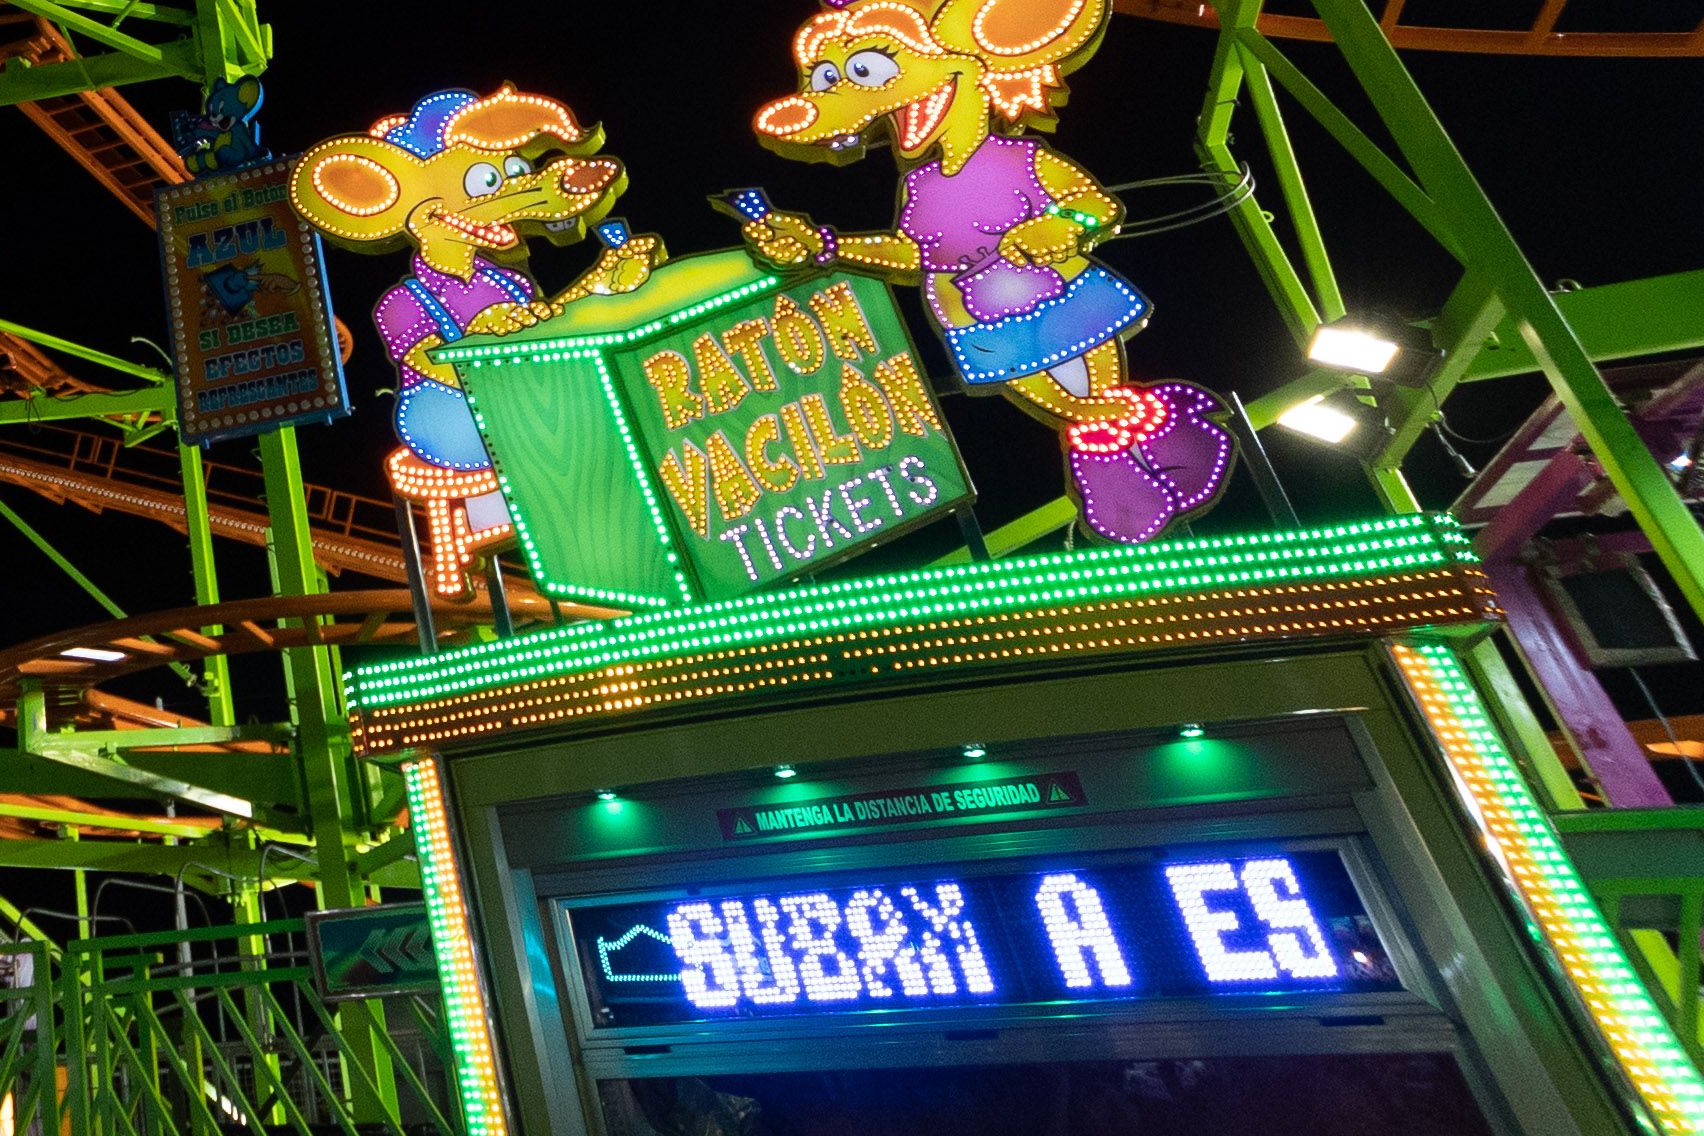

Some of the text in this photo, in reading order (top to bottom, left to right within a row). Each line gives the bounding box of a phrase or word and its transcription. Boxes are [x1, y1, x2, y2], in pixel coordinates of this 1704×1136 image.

[174, 201, 218, 224] Pulse
[224, 192, 237, 212] el
[187, 216, 287, 268] AZUL
[199, 311, 300, 351] SI DESEA
[203, 339, 305, 381] EFECTOS
[197, 368, 318, 413] REFRESCANTES
[719, 455, 937, 582] TICKETS
[755, 782, 1041, 831] MANTENGA LA DISTANCIA DE SEGURIDAD
[1034, 872, 1132, 988] A
[1163, 858, 1340, 980] ES
